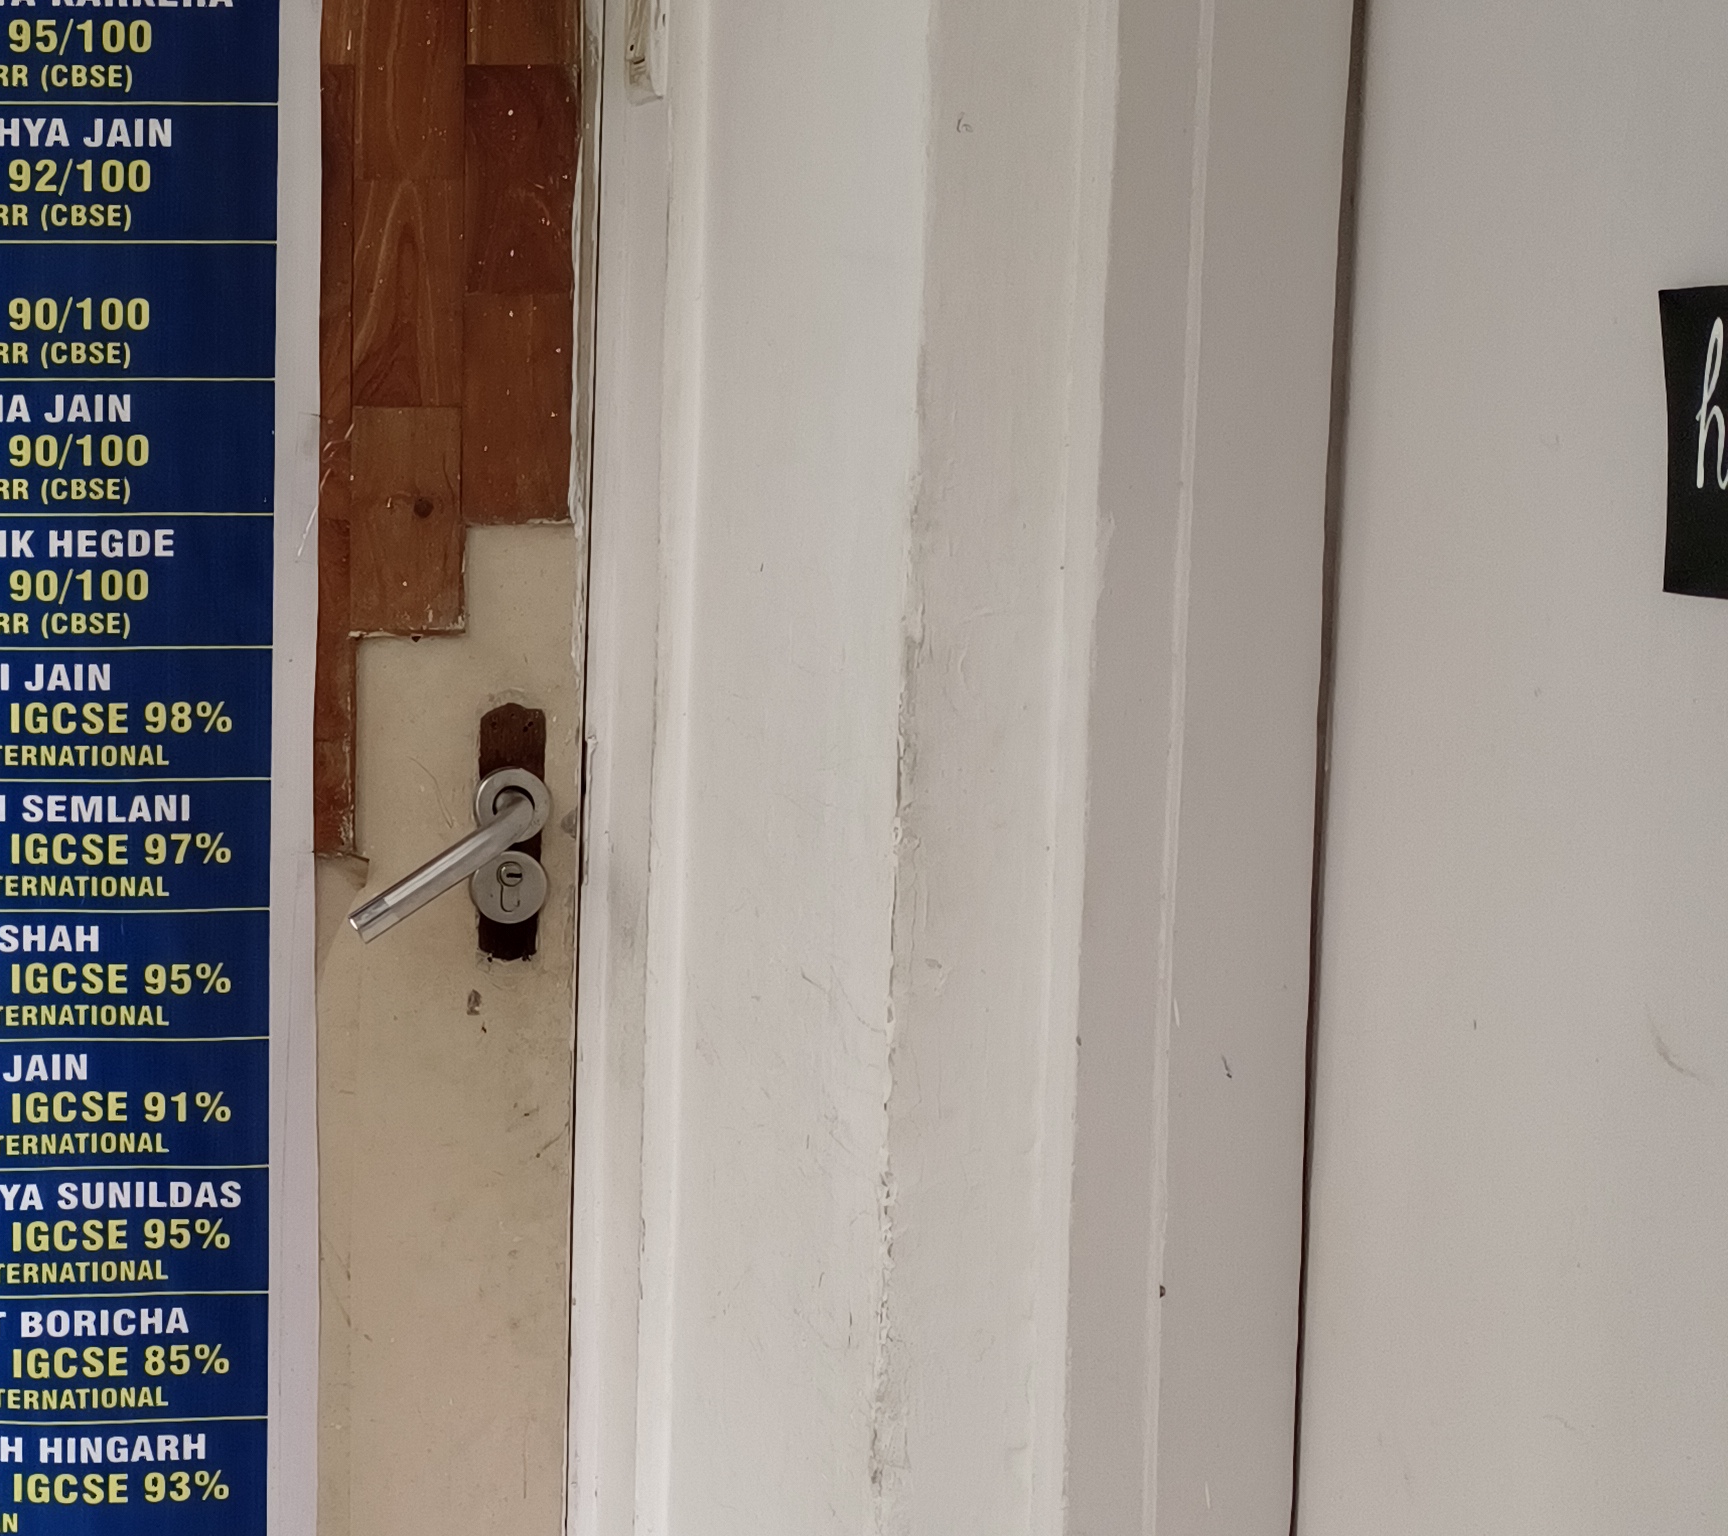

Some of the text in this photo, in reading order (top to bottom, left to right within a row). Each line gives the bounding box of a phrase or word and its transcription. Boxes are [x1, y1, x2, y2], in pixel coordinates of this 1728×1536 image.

[8, 18, 152, 56] 95/100
[40, 64, 133, 93] (CBSE)
[82, 118, 172, 148] JAIN
[8, 158, 151, 197] 92/100
[40, 203, 132, 232] (CBSE)
[8, 296, 150, 334] 90/100
[40, 341, 131, 370] (CBSE)
[43, 393, 131, 423] JAIN
[8, 433, 150, 471] 90/100
[40, 477, 131, 505] (CBSE)
[48, 528, 175, 558] HEGDE
[9, 568, 149, 605] 90/100
[41, 612, 131, 640] (CBSE)
[24, 663, 111, 692] JAIN
[10, 701, 129, 735] IGCSE
[144, 701, 233, 734] 98%
[21, 794, 190, 823] SEMLANI
[11, 832, 129, 866] IGCSE
[144, 832, 232, 865] 97%
[11, 962, 128, 995] IGCSE
[144, 962, 232, 995] 95%
[2, 1053, 88, 1083] JAIN
[11, 1090, 128, 1124] IGCSE
[143, 1091, 232, 1123] 91%
[57, 1180, 242, 1210] SUNILDAS
[12, 1219, 128, 1252] IGCSE
[143, 1218, 231, 1249] 95%
[20, 1307, 190, 1338] BORICHA
[12, 1346, 129, 1379] IGCSE
[144, 1343, 230, 1376] 85%
[39, 1433, 206, 1464] HINGARH
[13, 1473, 129, 1505] IGCSE
[144, 1469, 230, 1503] 93%
